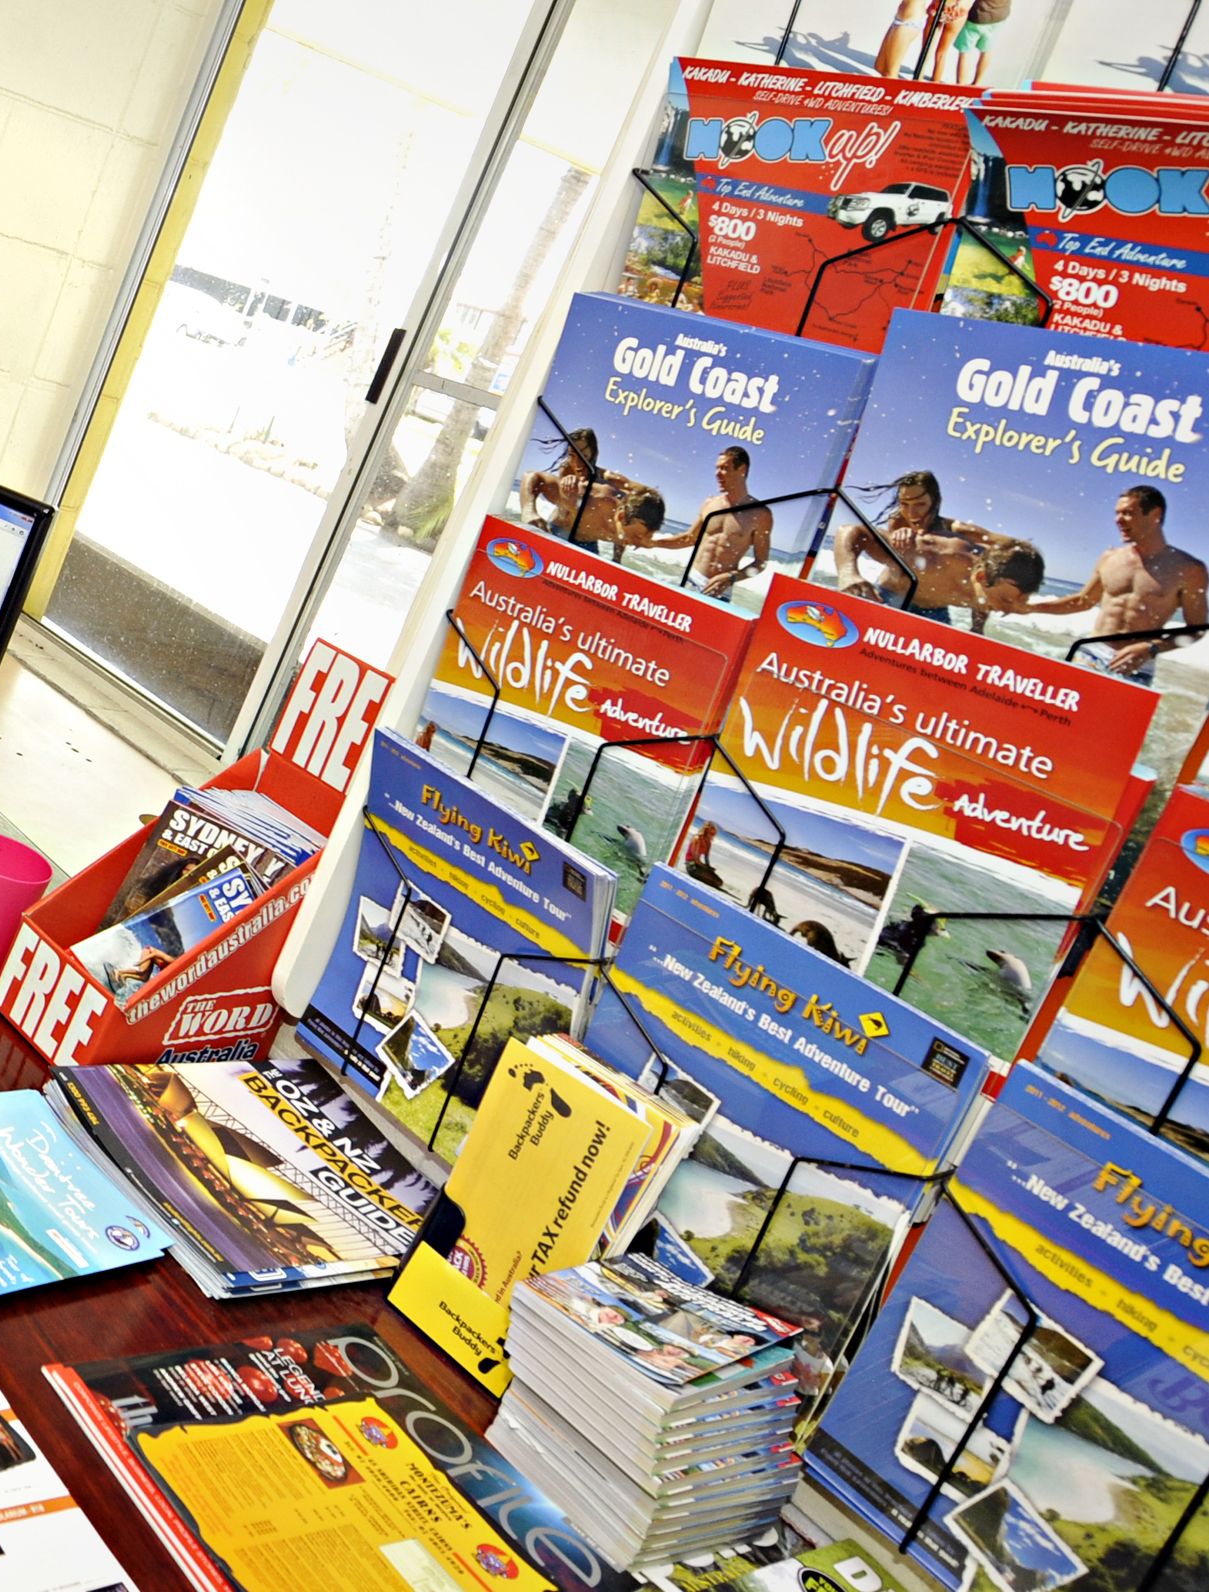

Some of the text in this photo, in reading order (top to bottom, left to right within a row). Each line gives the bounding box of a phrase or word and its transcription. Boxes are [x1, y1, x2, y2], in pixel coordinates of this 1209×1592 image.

[682, 66, 730, 82] KAKADU
[739, 72, 808, 93] KATHERINE
[814, 81, 886, 102] LITCHFIELD
[982, 115, 1049, 132] KAKADU
[1063, 121, 1164, 141] KATHERINE
[715, 178, 806, 208] Top End Adventure
[721, 202, 804, 228] Days Nights
[708, 215, 757, 241] $800
[709, 245, 749, 262] KAKADU
[1058, 232, 1187, 269] Top End Adventure
[707, 257, 761, 274] LITCHFIELD
[1049, 275, 1119, 308] $800
[1053, 259, 1187, 293] 4 Days 3 Nights
[675, 333, 728, 357] Australia's
[1053, 313, 1112, 332] KAKADU
[1114, 324, 1123, 335] &
[613, 337, 780, 414] Gold Coast
[1044, 350, 1122, 377] Australia's
[604, 376, 765, 445] Explorer's Guide
[956, 358, 1203, 443] Gold Coast
[947, 406, 1186, 483] Explorer's Guide
[546, 560, 620, 602] NULLARBOR
[621, 592, 693, 633] TRAVELLER
[469, 580, 573, 642] Australia's
[577, 632, 672, 688] ultimate
[456, 617, 595, 716] Wildlife
[862, 627, 1081, 712] NULLARBOR TRAVELLER
[270, 640, 391, 793] FRE
[599, 698, 693, 745] Adventure
[756, 651, 1055, 781] Australia's ultimate
[1039, 708, 1072, 727] Perth
[739, 697, 949, 817] Wildlife
[161, 828, 174, 841] &
[173, 833, 208, 856] EAST
[169, 808, 265, 864] SYDNEY
[420, 783, 533, 875] Flying Kiwi
[952, 793, 1090, 853] Adventure
[416, 814, 541, 904] Zealand's Best Adventure
[126, 873, 316, 1025] thewordaustralia.co
[178, 1002, 273, 1038] WORD
[186, 999, 217, 1013] THE
[708, 934, 870, 1056] Flying Kiwi
[156, 1038, 260, 1065] Australia
[692, 970, 757, 1023] Zealand's
[757, 1010, 794, 1045] Best
[793, 1036, 871, 1092] Adventure
[261, 1067, 283, 1081] THE
[276, 1079, 382, 1174] OZ & NZ
[507, 1090, 546, 1161] Backpackers
[531, 1109, 556, 1147] Buddy
[771, 1075, 811, 1107] cycling
[821, 1106, 860, 1139] culture
[319, 1168, 417, 1247] GUIDE
[531, 1119, 612, 1267] TAX refund now!
[1093, 1161, 1209, 1268] Flying
[1035, 1243, 1095, 1289] activities
[1068, 1201, 1209, 1306] Zealand's Best
[438, 1300, 498, 1355] Backpackers
[452, 1325, 483, 1357] Buddy
[261, 1345, 285, 1372] AT
